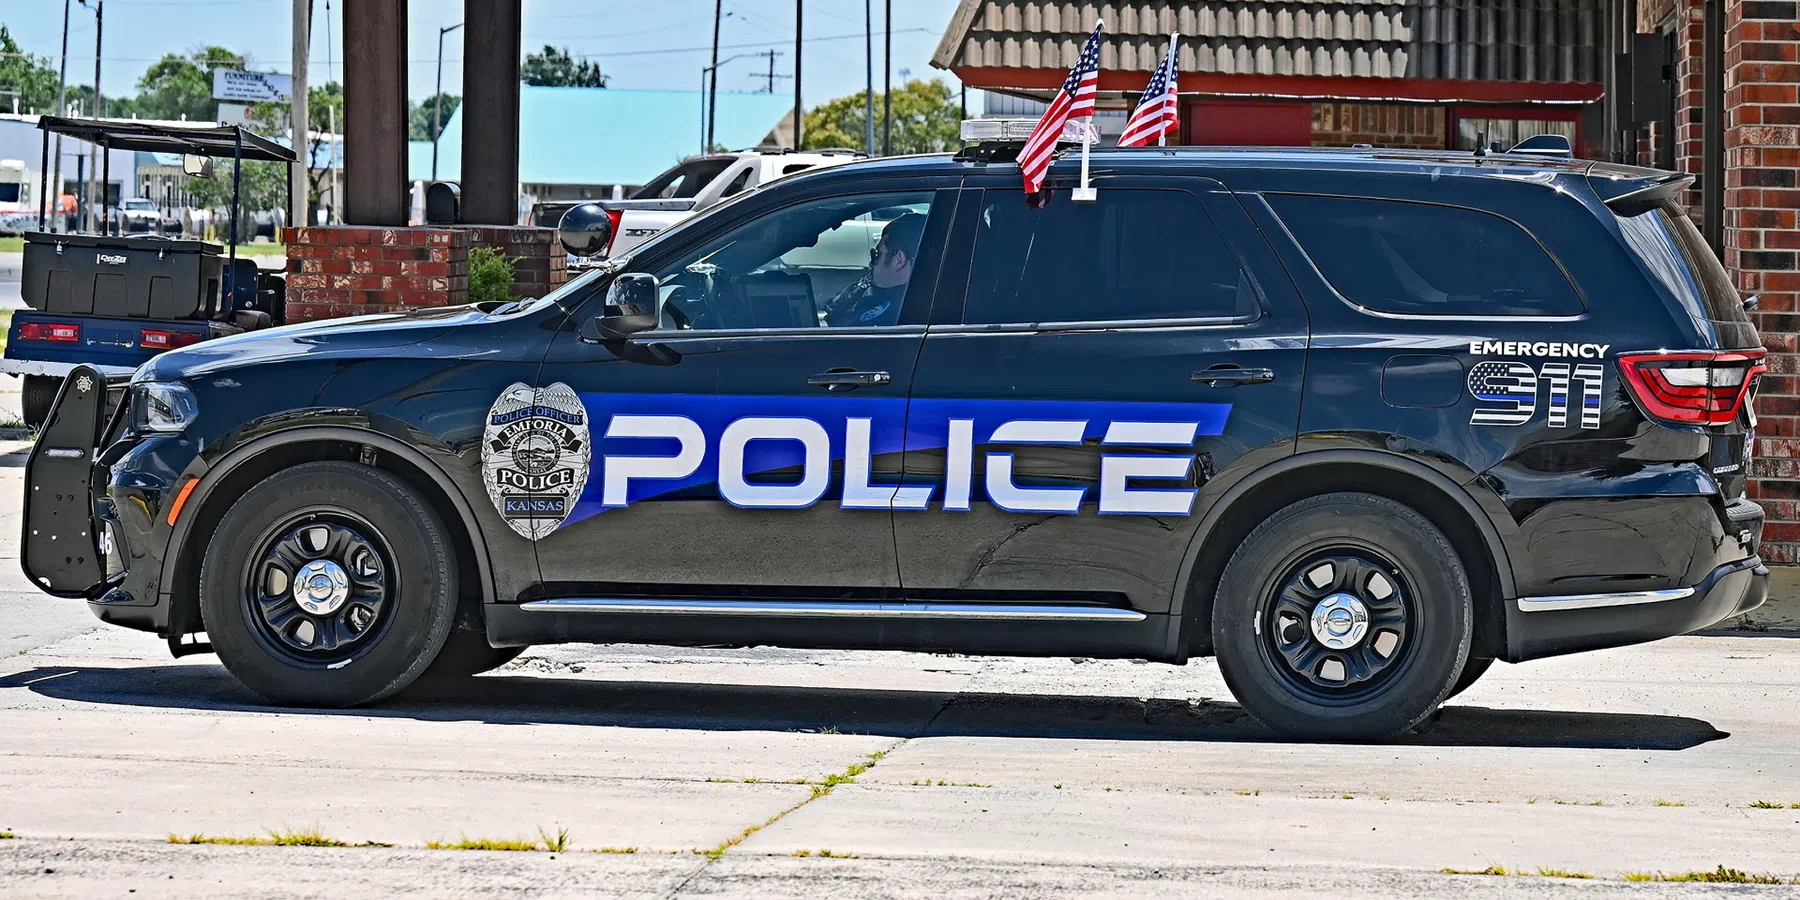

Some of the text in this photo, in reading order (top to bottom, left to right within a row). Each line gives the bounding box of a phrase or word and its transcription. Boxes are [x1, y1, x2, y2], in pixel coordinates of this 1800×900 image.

[225, 72, 264, 82] FURNITURE
[1469, 341, 1610, 360] EMERGENCY
[1467, 361, 1604, 429] 911
[493, 406, 581, 425] POLICE OFFICER
[504, 419, 568, 438] EMPORIA
[601, 413, 1201, 515] POLICE
[501, 469, 571, 489] POLICE
[506, 500, 564, 512] KANSAS
[99, 531, 113, 555] 46
